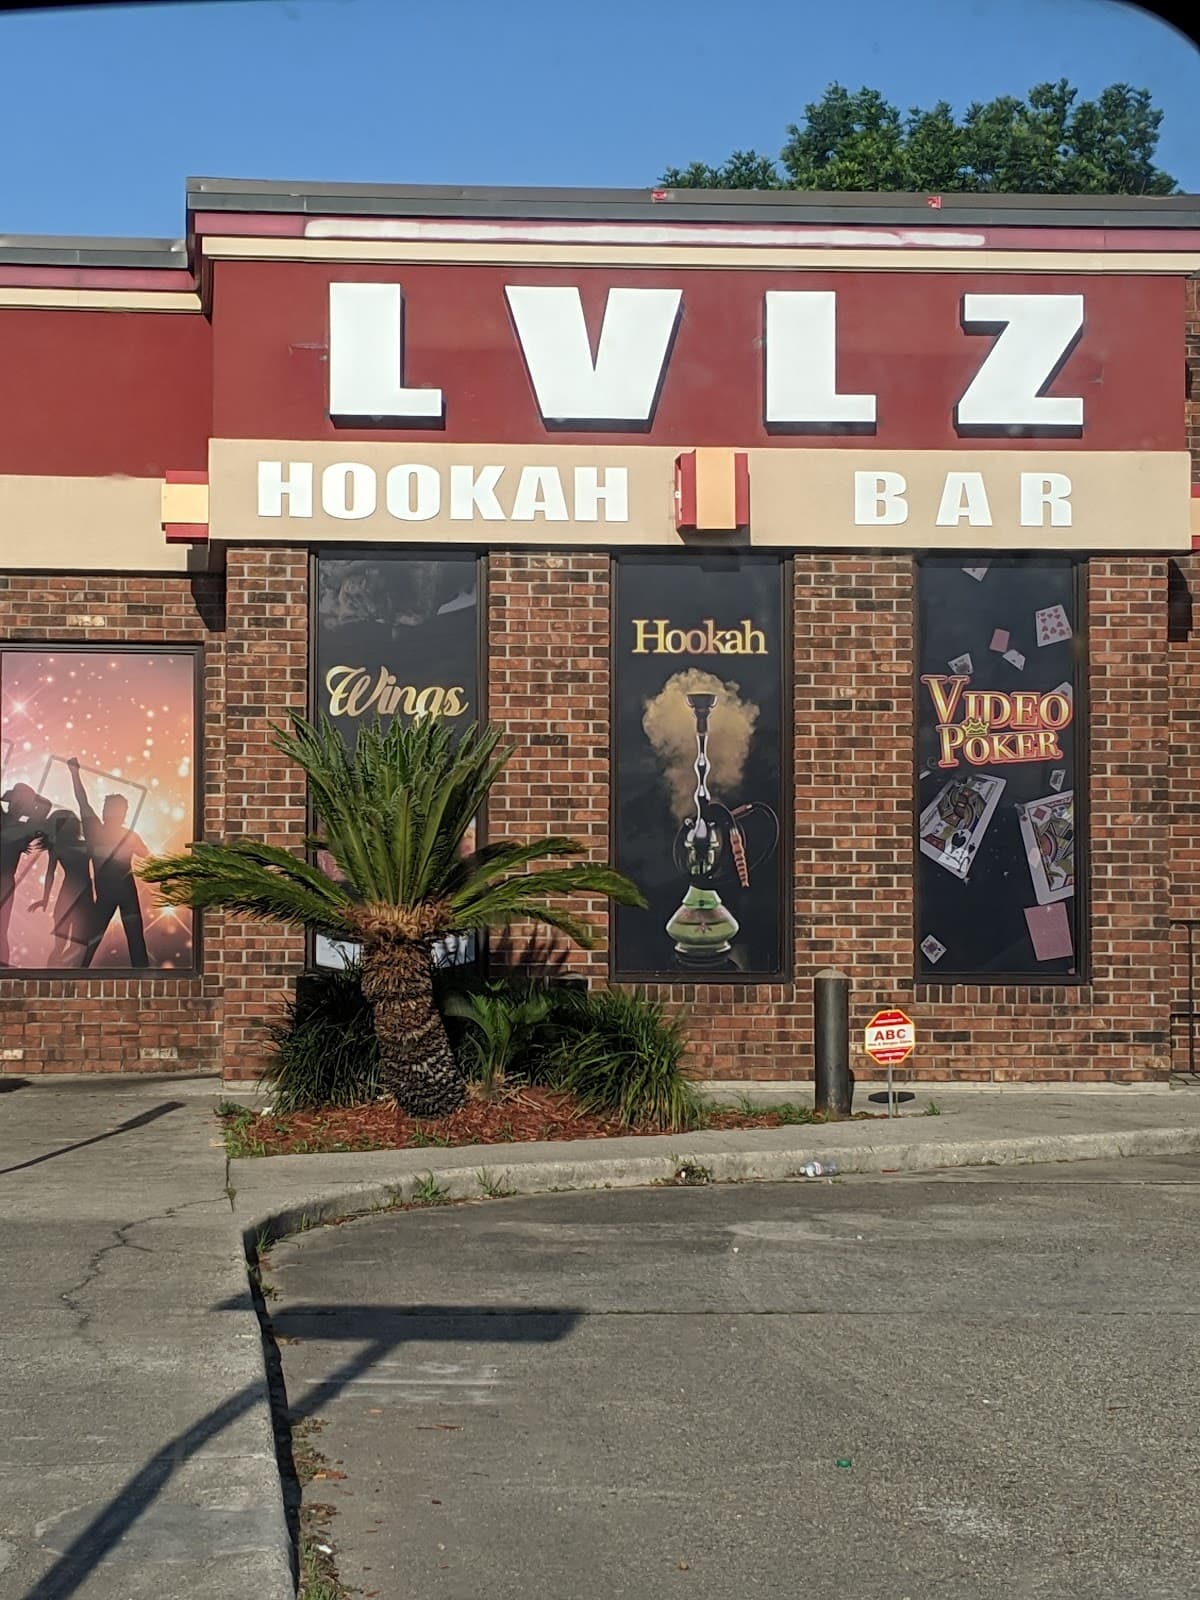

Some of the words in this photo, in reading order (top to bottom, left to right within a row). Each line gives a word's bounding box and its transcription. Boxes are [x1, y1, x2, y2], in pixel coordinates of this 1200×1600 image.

[329, 281, 1085, 427] LVLZ
[257, 461, 629, 522] HOOKAH
[854, 470, 1073, 527] BAR
[631, 618, 769, 655] Hookah
[325, 664, 470, 728] Wings
[920, 674, 1074, 731] VIDEO
[936, 723, 1064, 769] POKER
[873, 1028, 907, 1043] ABC
